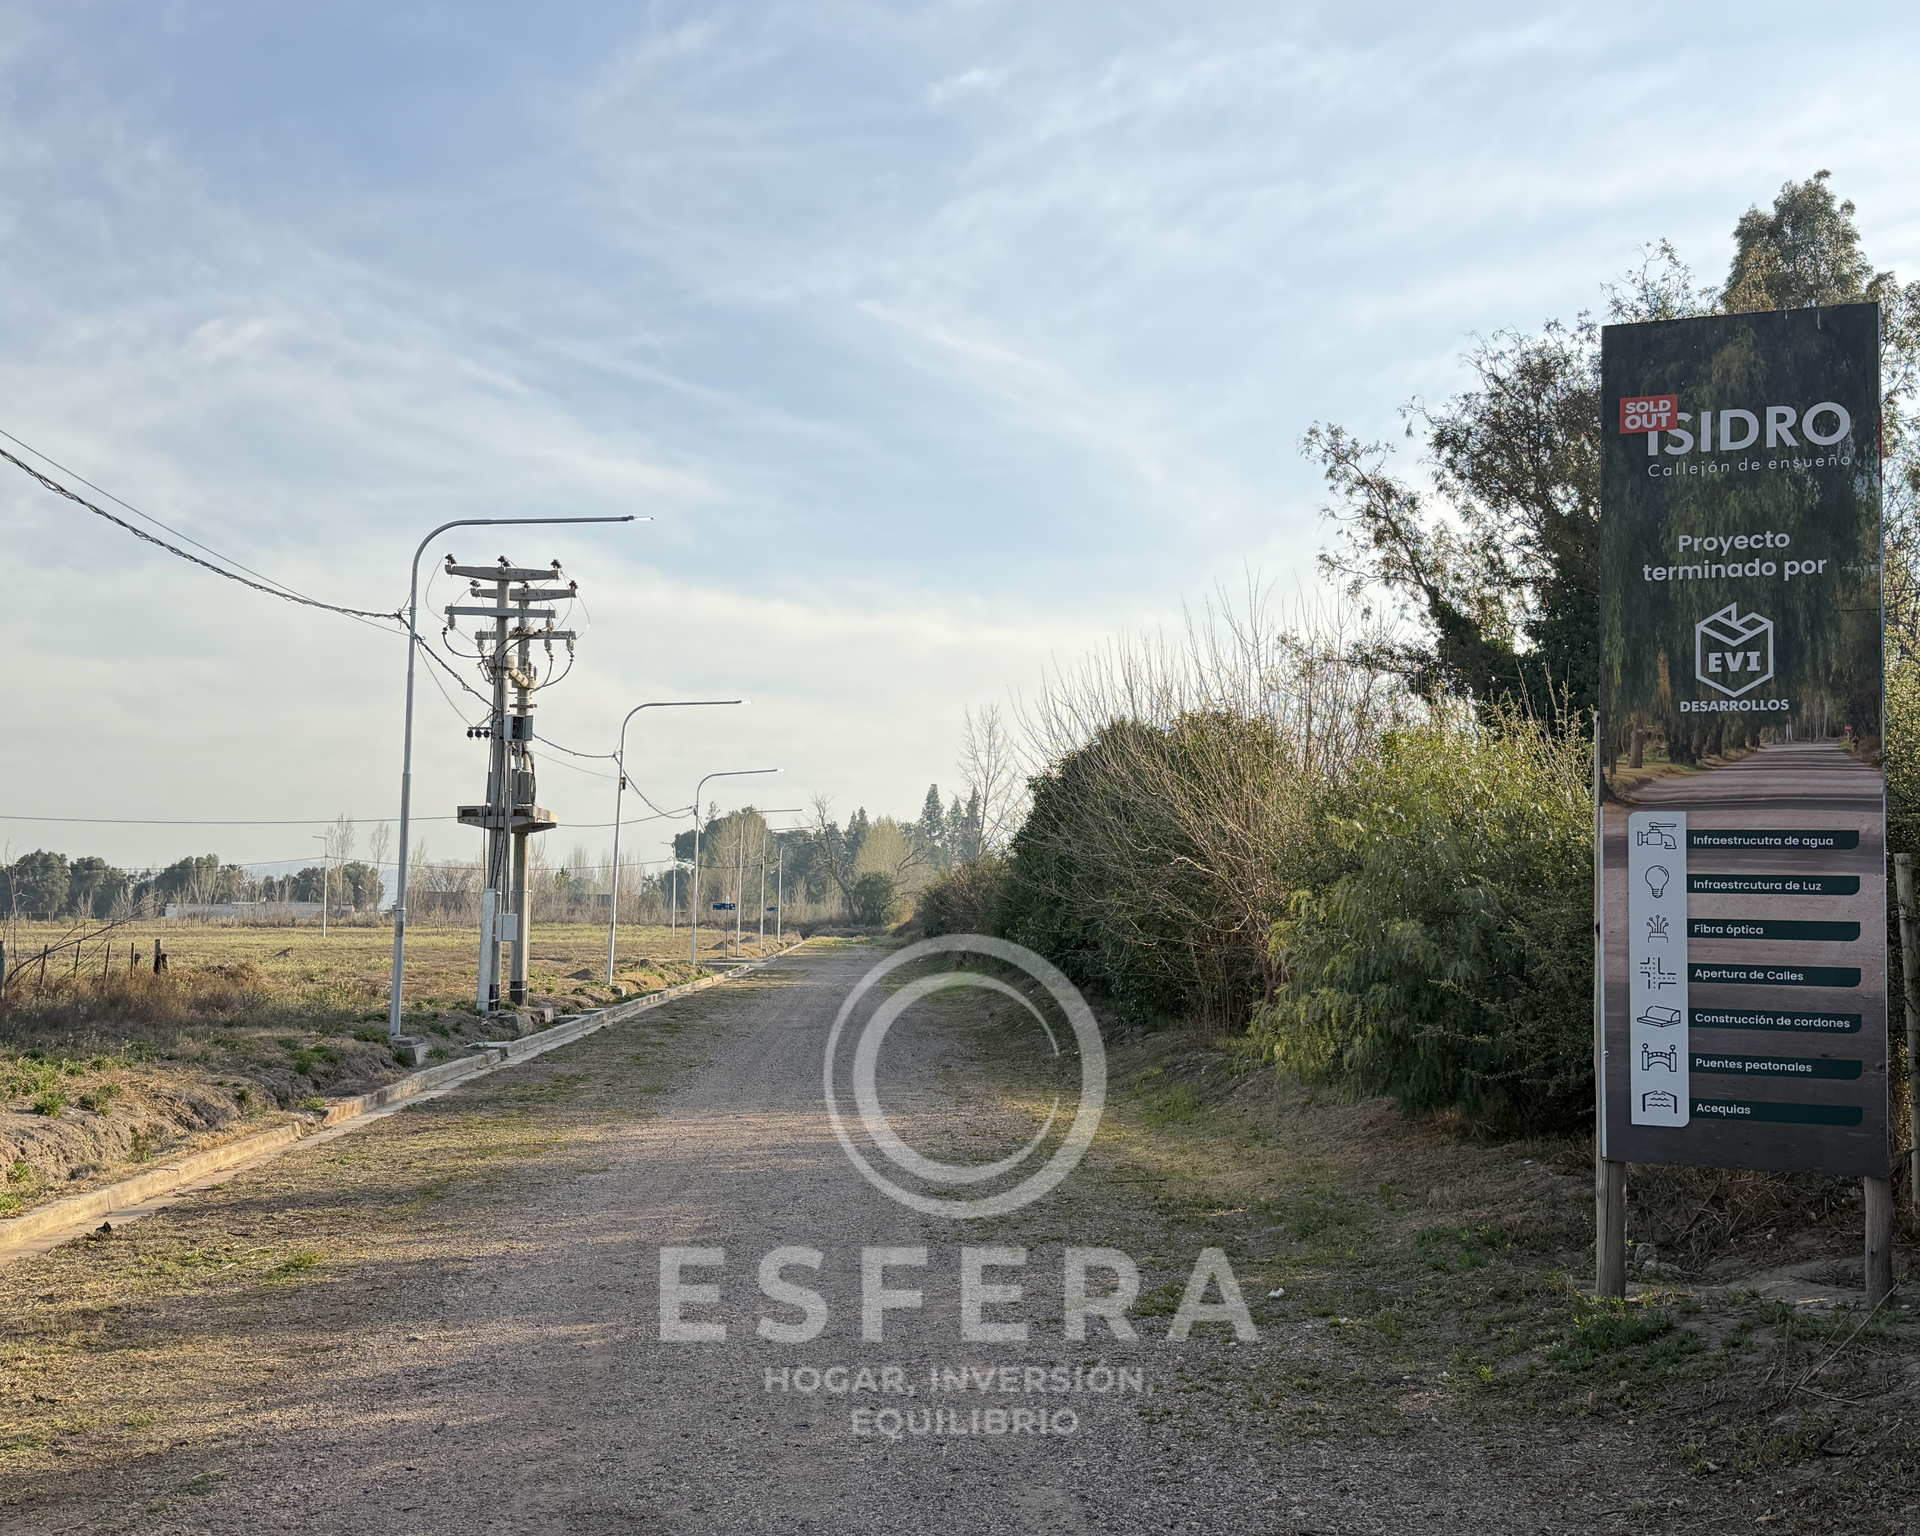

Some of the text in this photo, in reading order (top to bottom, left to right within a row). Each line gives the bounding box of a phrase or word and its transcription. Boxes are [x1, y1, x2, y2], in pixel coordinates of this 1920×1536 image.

[1625, 399, 1671, 414] SOLD
[1624, 412, 1671, 430] OUT
[1647, 401, 1851, 456] ISIDRO
[1648, 454, 1851, 478] Callejón de ensueño
[1678, 530, 1790, 556] Proyecto
[1643, 558, 1827, 581] terminado por
[1708, 651, 1761, 673] EVI
[1680, 699, 1790, 712] DESARROLLOS
[1784, 836, 1800, 846] de
[1802, 838, 1834, 848] agua
[1785, 881, 1801, 891] de
[1802, 882, 1822, 891] Luz
[1694, 924, 1764, 936] Fibra óptica
[1695, 969, 1804, 982] Apertura de Calles
[1695, 1013, 1851, 1028] Construcción de cordones
[1696, 1058, 1813, 1073] Puentes peatonales
[1696, 1103, 1751, 1116] Acequias
